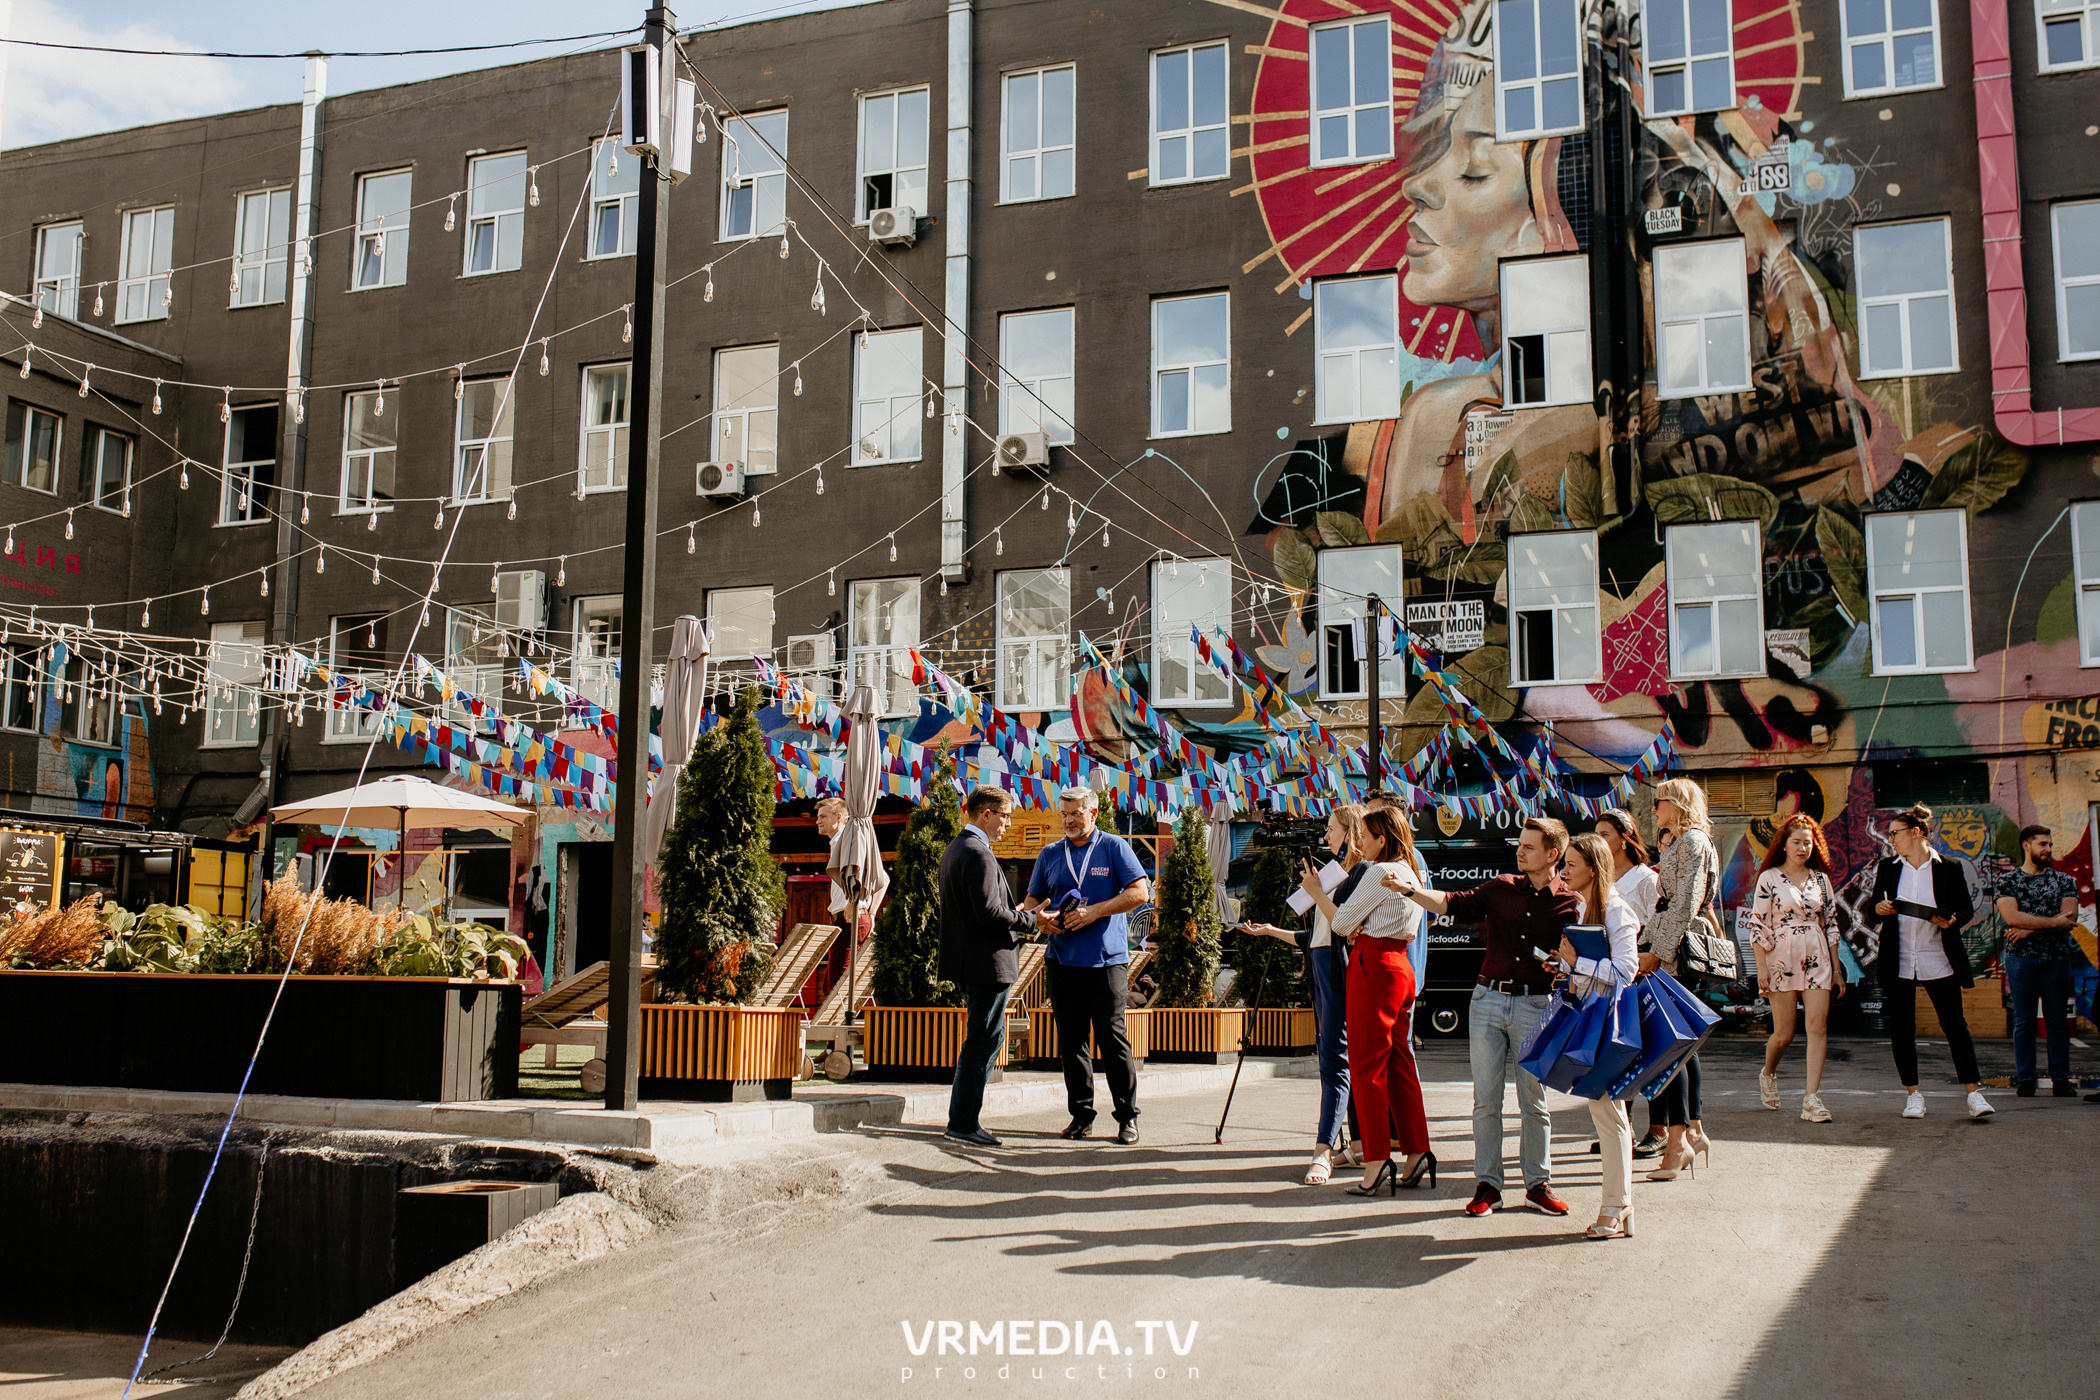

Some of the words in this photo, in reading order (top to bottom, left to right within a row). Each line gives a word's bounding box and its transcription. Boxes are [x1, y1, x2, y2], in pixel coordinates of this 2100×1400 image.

[1649, 209, 1677, 221] BLACK
[1646, 219, 1681, 231] TUESDAY
[0, 576, 55, 597] ранство
[1408, 605, 1436, 621] MAN
[1440, 603, 1457, 618] ON
[1460, 602, 1482, 617] THE
[1446, 617, 1482, 633] MOON
[18, 885, 34, 893] WOK
[1427, 935, 1470, 944] dicfood42
